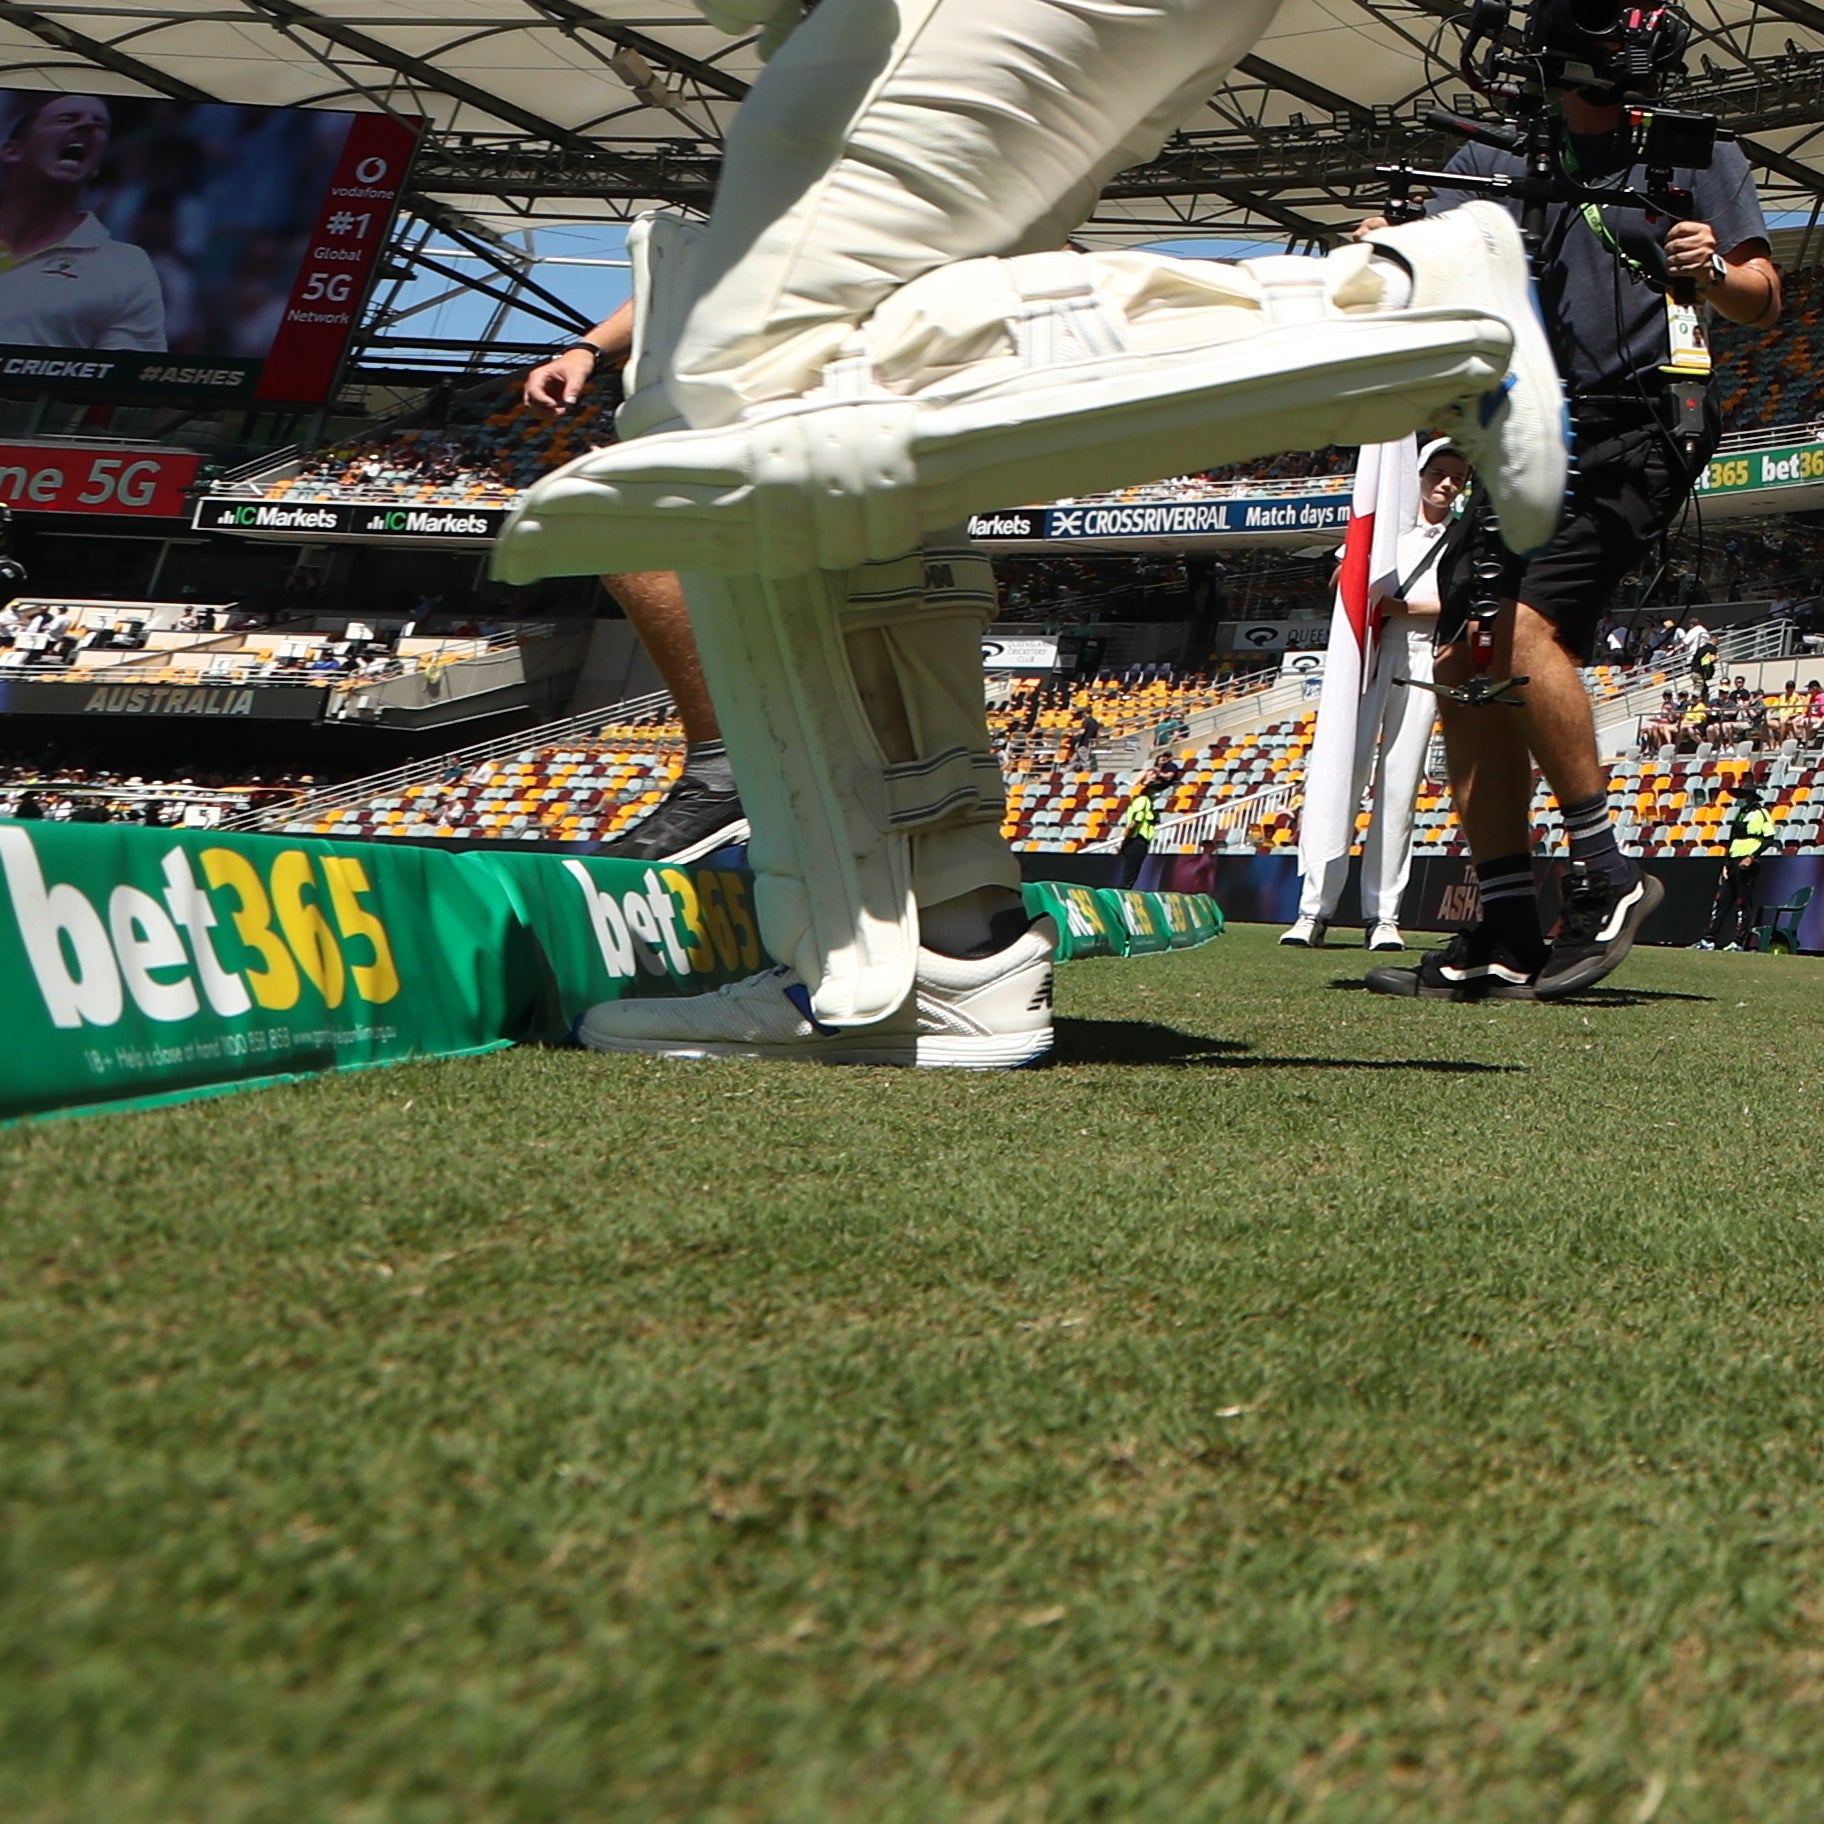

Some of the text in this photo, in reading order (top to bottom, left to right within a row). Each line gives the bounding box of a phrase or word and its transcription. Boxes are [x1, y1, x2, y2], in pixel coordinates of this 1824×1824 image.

[331, 187, 395, 200] vodafone
[326, 211, 372, 239] #1
[314, 246, 362, 261] Global
[302, 273, 353, 302] 5G
[287, 309, 350, 325] Network
[4, 358, 247, 386] CRICKET #ASHES
[77, 459, 162, 507] 5G
[1245, 505, 1296, 526] Match
[1300, 503, 1334, 529] days
[84, 687, 255, 715] AUSTRALIA
[0, 825, 400, 1029] bet365
[561, 859, 761, 979] bet365
